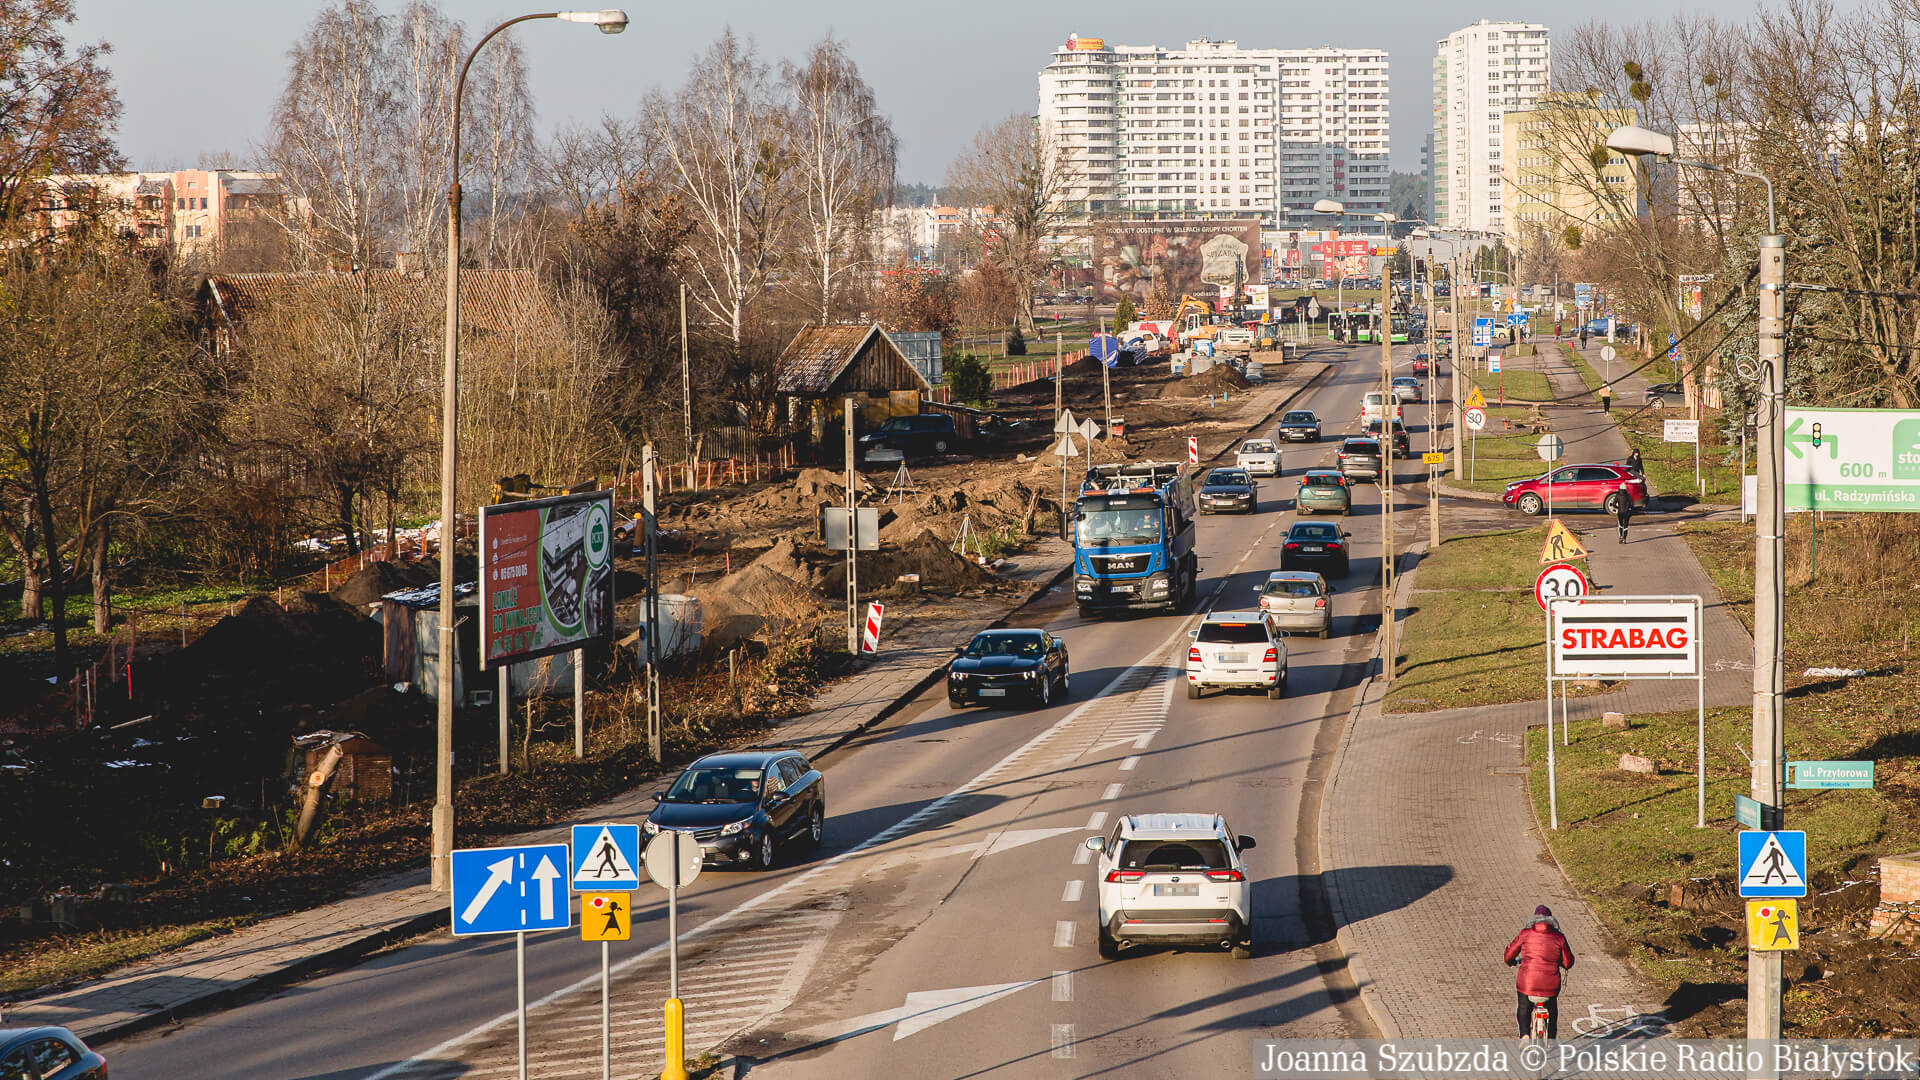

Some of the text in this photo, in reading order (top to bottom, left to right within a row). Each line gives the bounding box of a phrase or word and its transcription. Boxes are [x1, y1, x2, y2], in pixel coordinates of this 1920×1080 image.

[1467, 412, 1482, 424] 30
[1427, 454, 1440, 462] 675
[1839, 462, 1874, 478] 600
[1814, 490, 1916, 504] ul. Radzymińska
[1107, 562, 1134, 570] MAN
[1545, 577, 1581, 602] 30
[493, 587, 518, 611] LOKALE
[493, 612, 504, 633] DO
[1562, 627, 1688, 649] STRABAG
[1803, 767, 1869, 780] ul. Przytorowa
